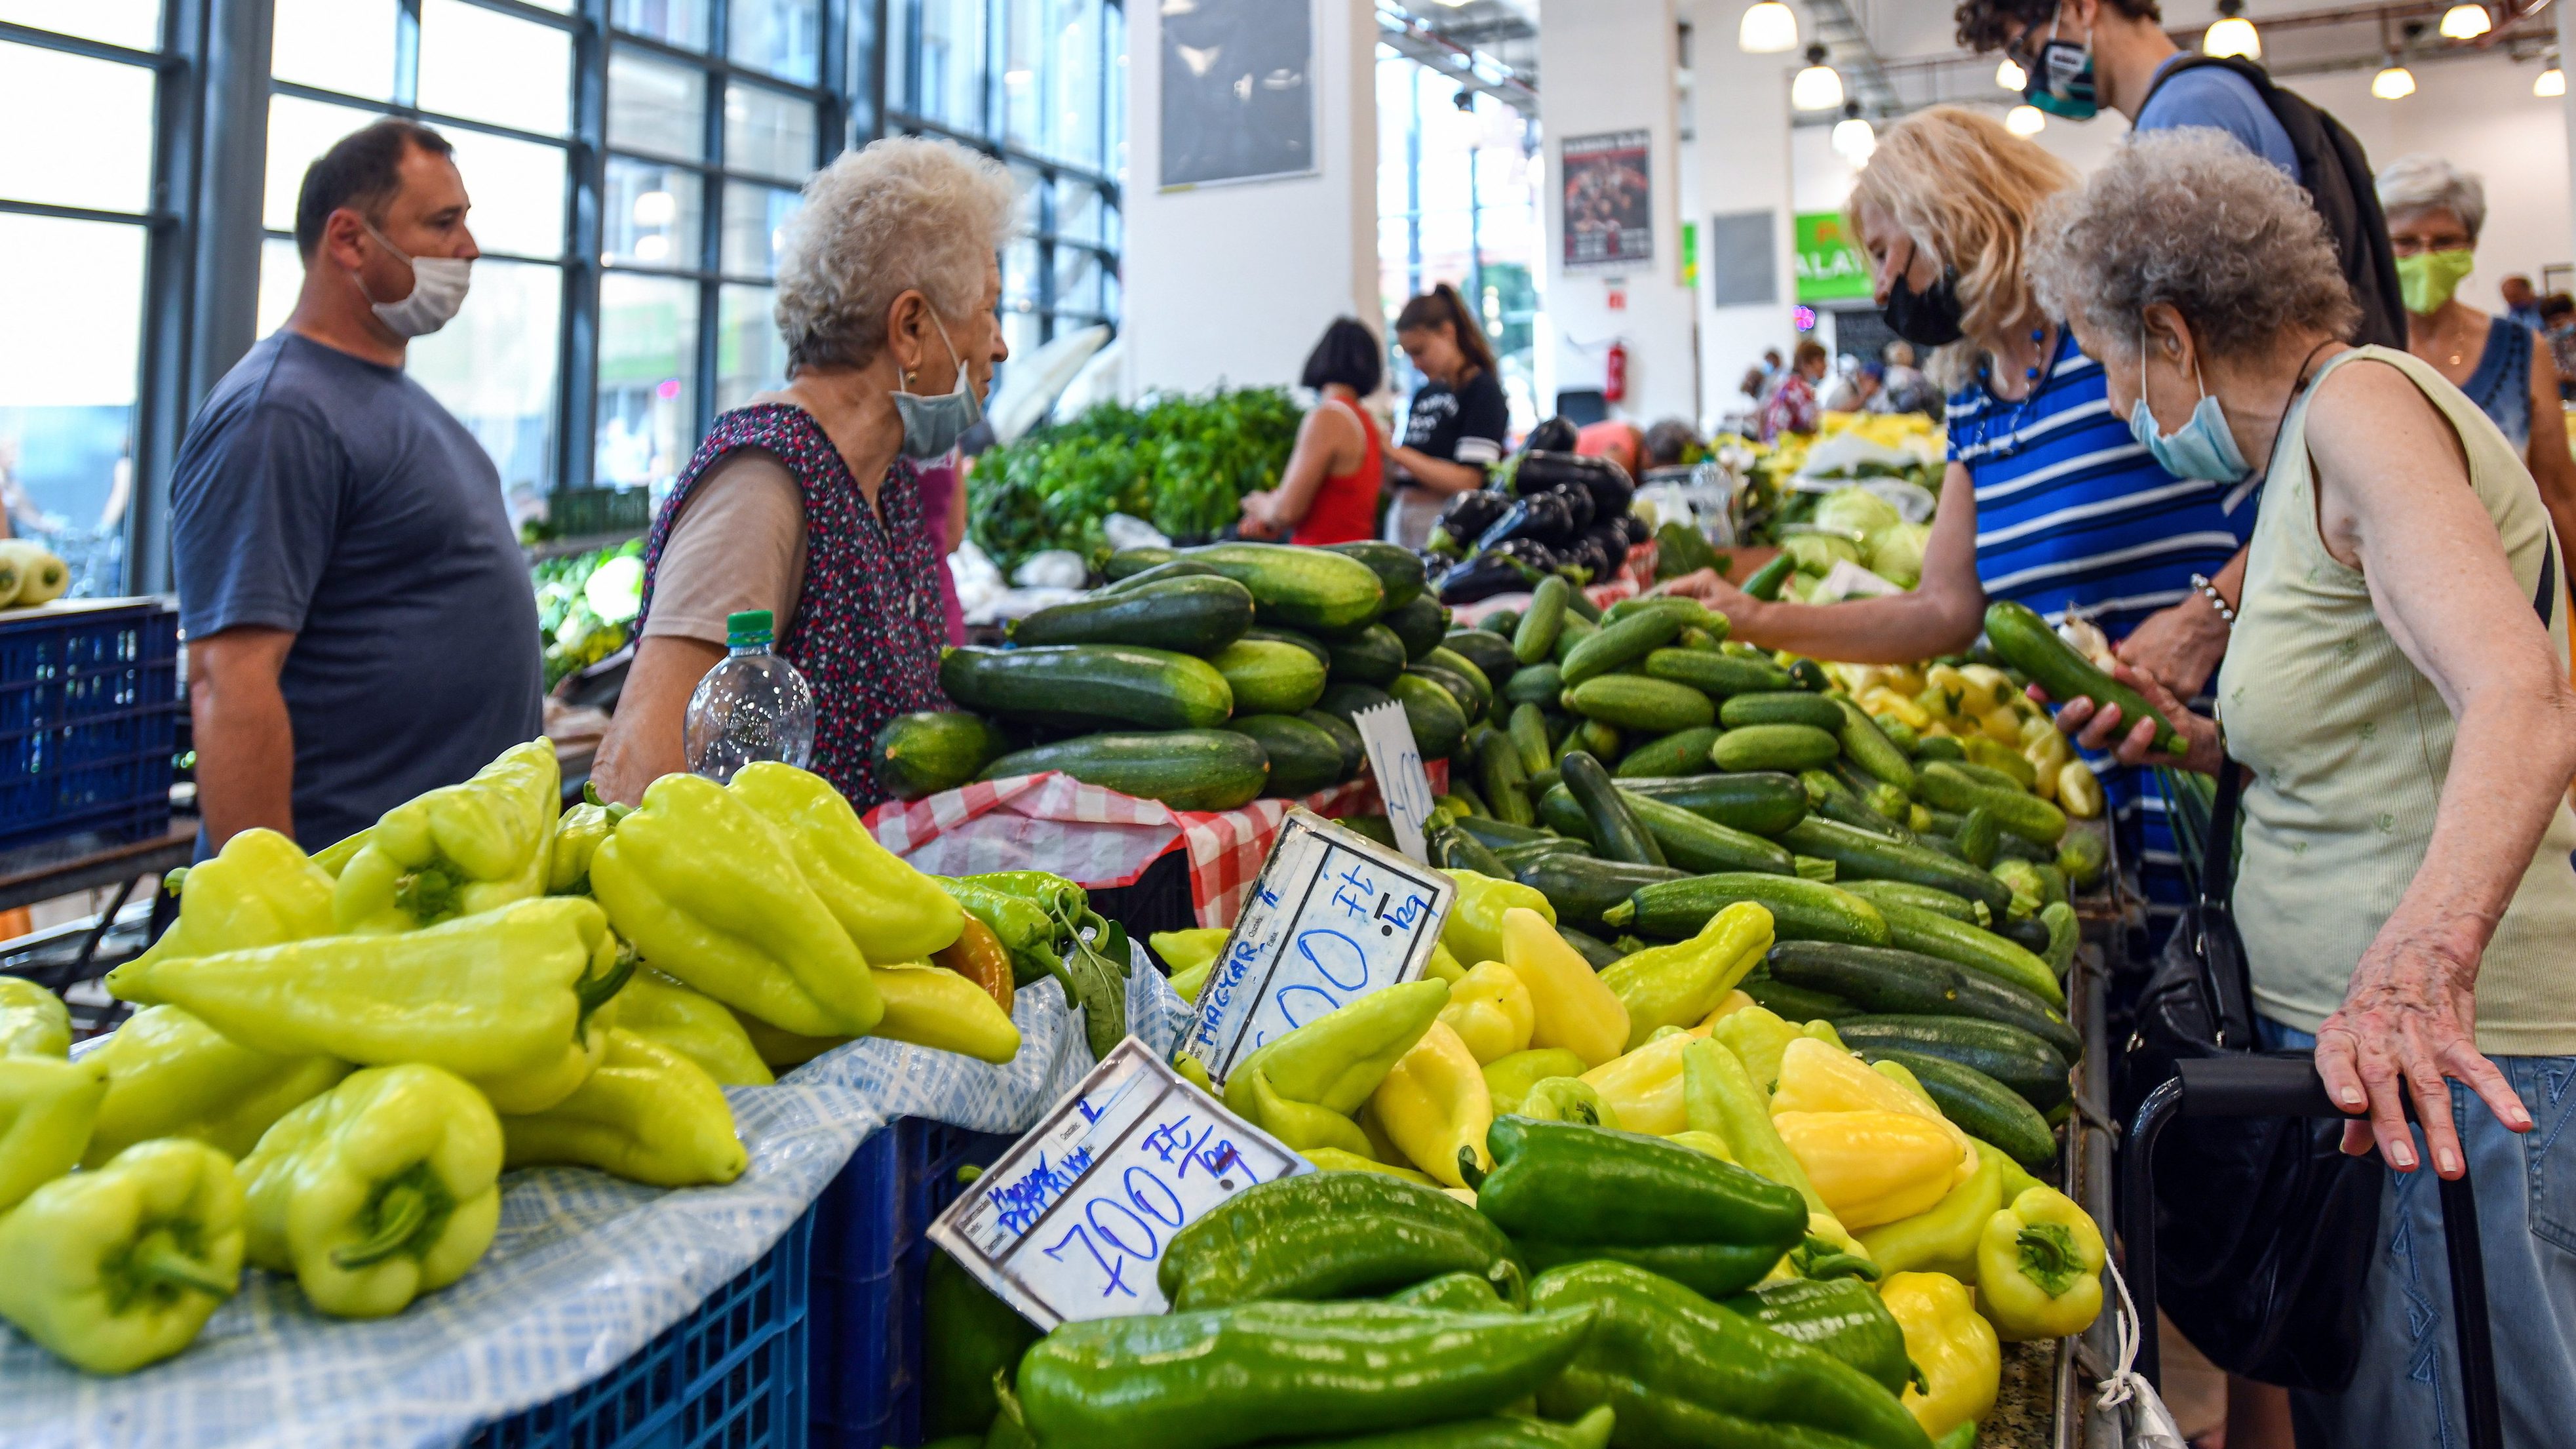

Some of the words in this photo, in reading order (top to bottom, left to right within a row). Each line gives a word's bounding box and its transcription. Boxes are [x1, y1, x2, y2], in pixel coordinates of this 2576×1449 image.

[1332, 865, 1374, 917] Ft
[1197, 941, 1258, 1046] MAGYAR
[1043, 1166, 1184, 1297] 700
